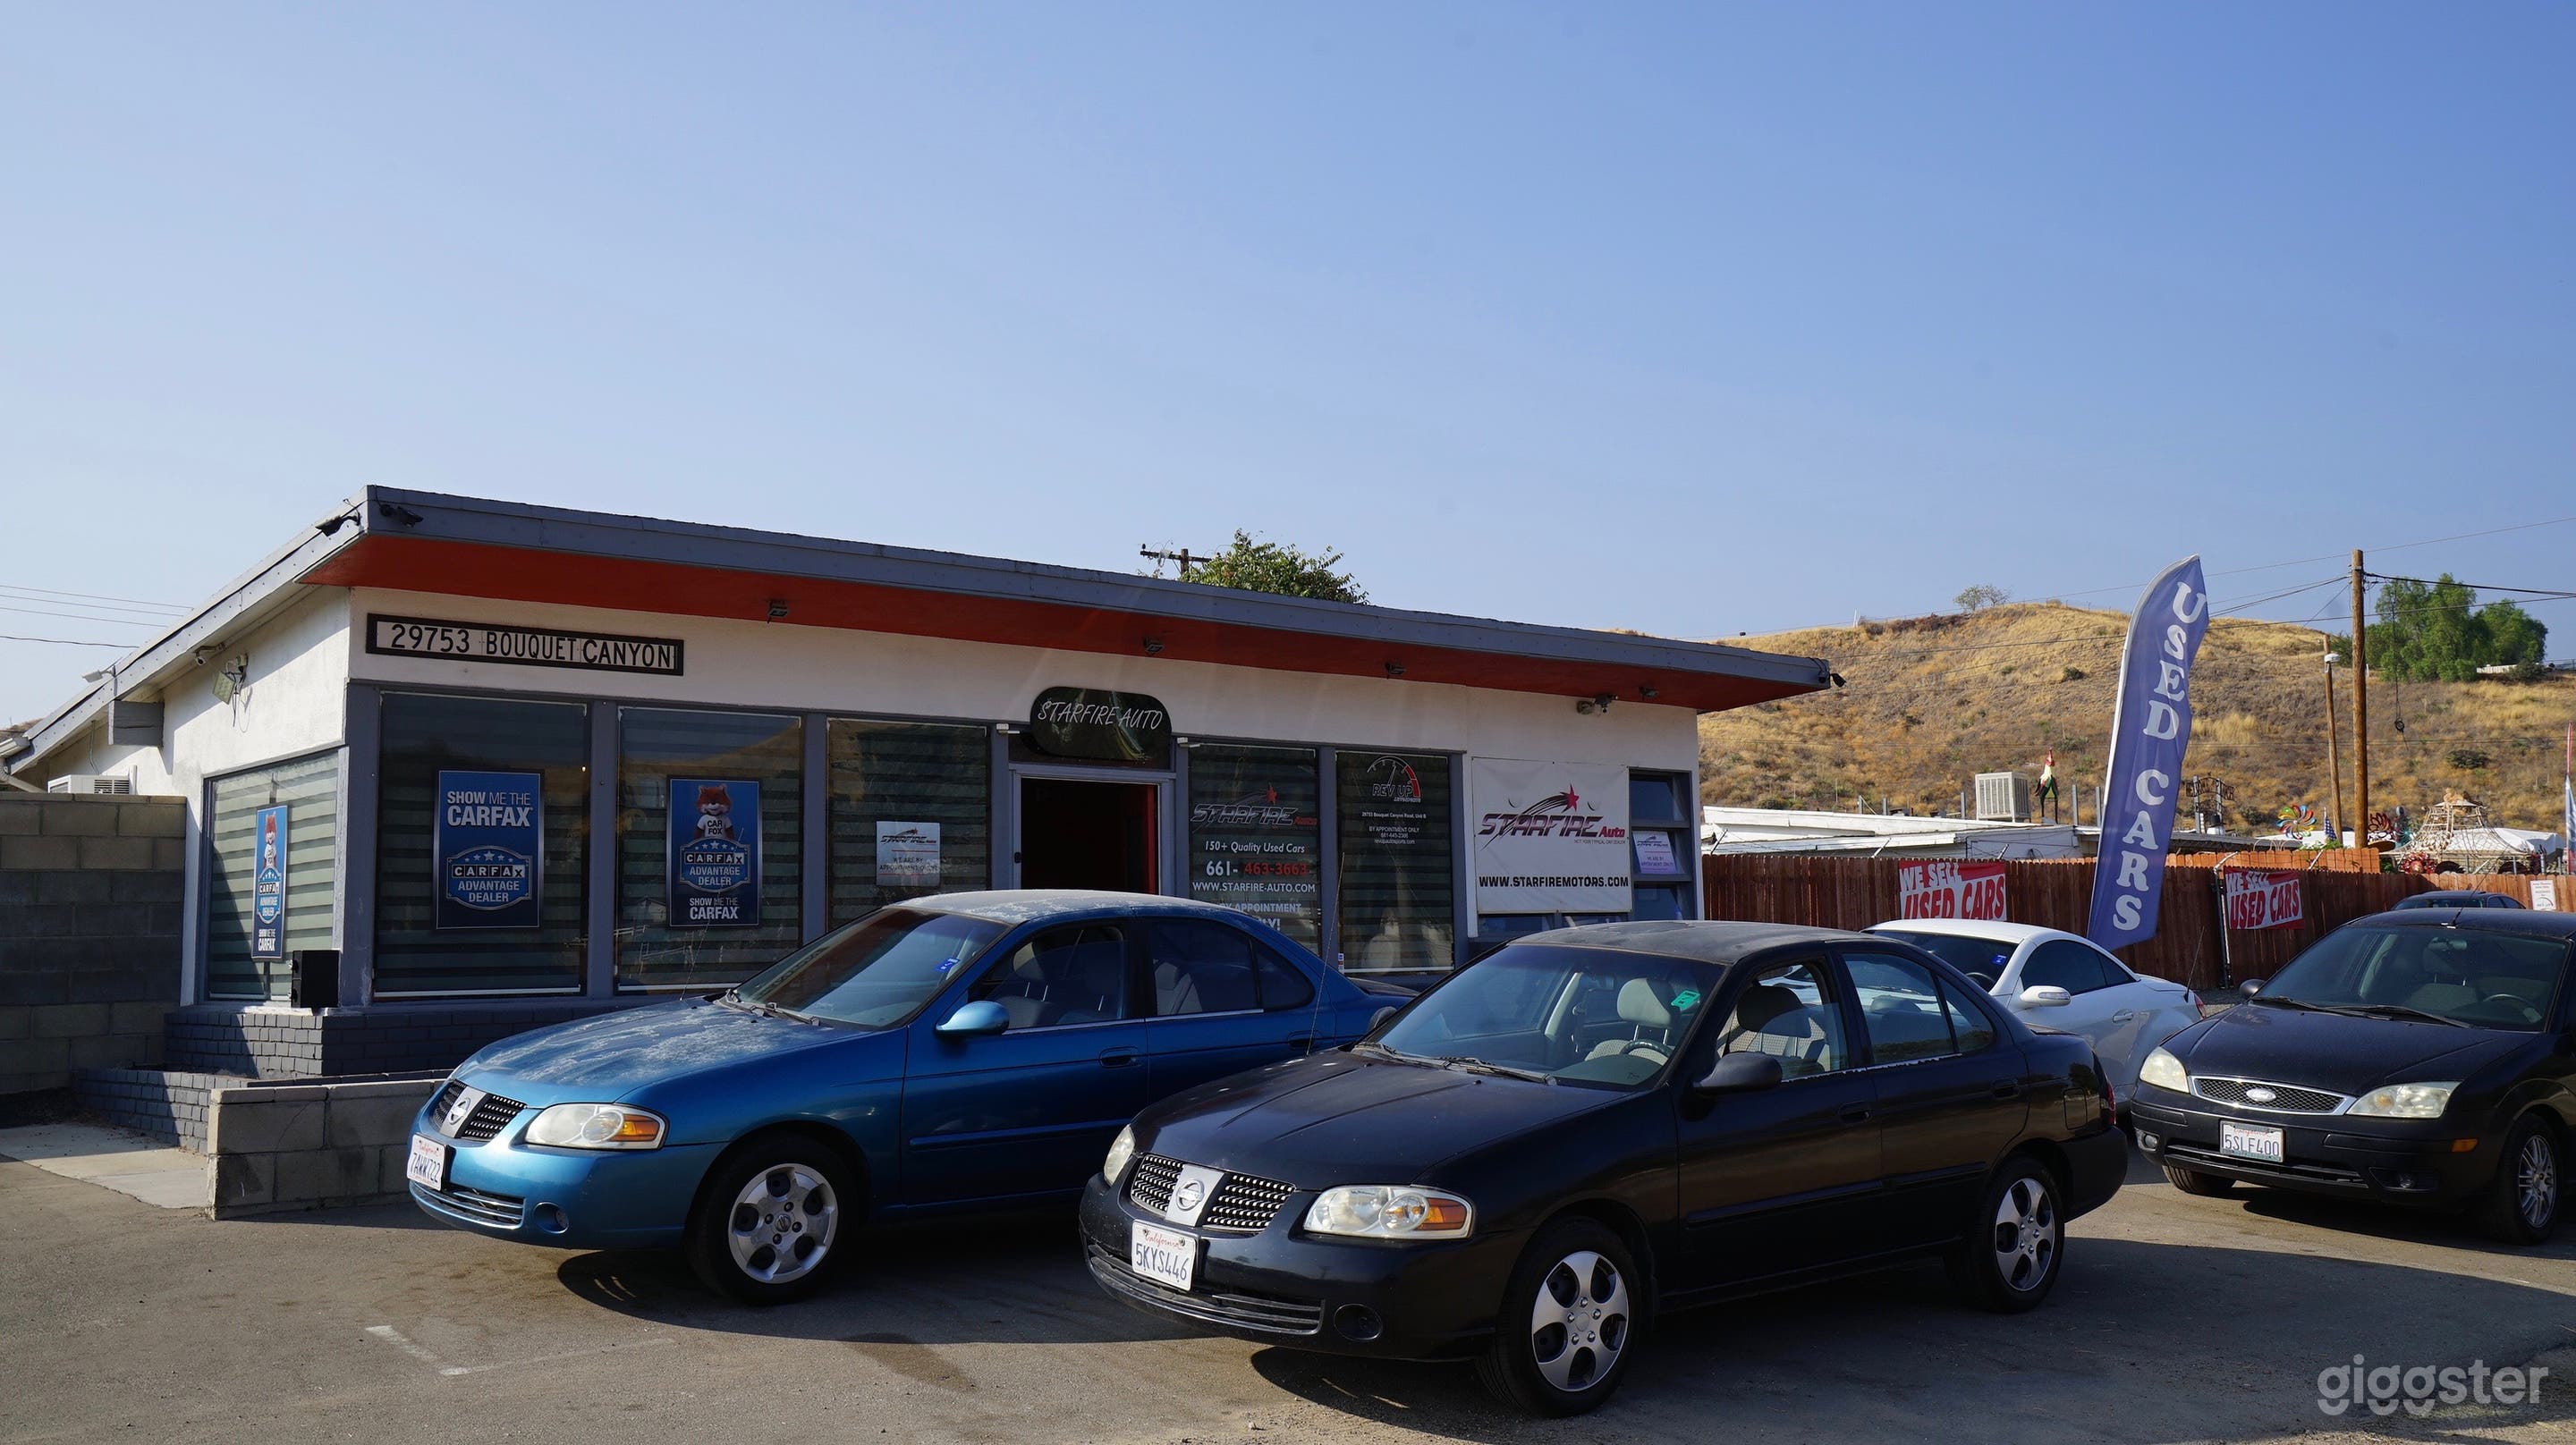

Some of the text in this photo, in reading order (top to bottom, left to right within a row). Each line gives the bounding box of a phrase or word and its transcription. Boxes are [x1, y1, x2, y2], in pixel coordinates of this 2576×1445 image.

[391, 623, 671, 668] 29753 BOUQUET CANYON
[1038, 700, 1163, 730] STARFIRE AUTO
[2113, 581, 2207, 931] USED CARS
[1373, 783, 1413, 798] REV UP
[447, 791, 530, 806] SHOW ME THE
[448, 806, 530, 827] CARFAX
[1190, 804, 1298, 826] STARFIRE
[1478, 813, 1625, 838] STARFIRE Auto
[1205, 841, 1305, 855] 150+ Quality Used Cars
[686, 854, 743, 865] CARFAX
[453, 865, 524, 877] CARFAX
[689, 866, 741, 875] ADVANTAGE
[1206, 860, 1238, 876] 661-
[698, 876, 732, 886] DEALER
[1479, 875, 1629, 888] WWW.STARFIREMOTORS.COM
[1900, 862, 1962, 892] WE SELL
[2225, 871, 2269, 896] WE SELL
[458, 881, 520, 891] ADVANTAGE
[1192, 882, 1316, 892] WWW.STARFIRE-AUTO.COM
[469, 892, 509, 902] DEALER
[689, 897, 738, 907] SHOW ME THE
[1903, 875, 2005, 920] USED CARS
[1234, 903, 1301, 913] APPOINTMENT
[2230, 883, 2301, 928] USED CARS
[690, 907, 739, 920] CARFAX
[2224, 1134, 2280, 1156] 5SLF400
[1136, 1242, 1190, 1280] 5KYS446
